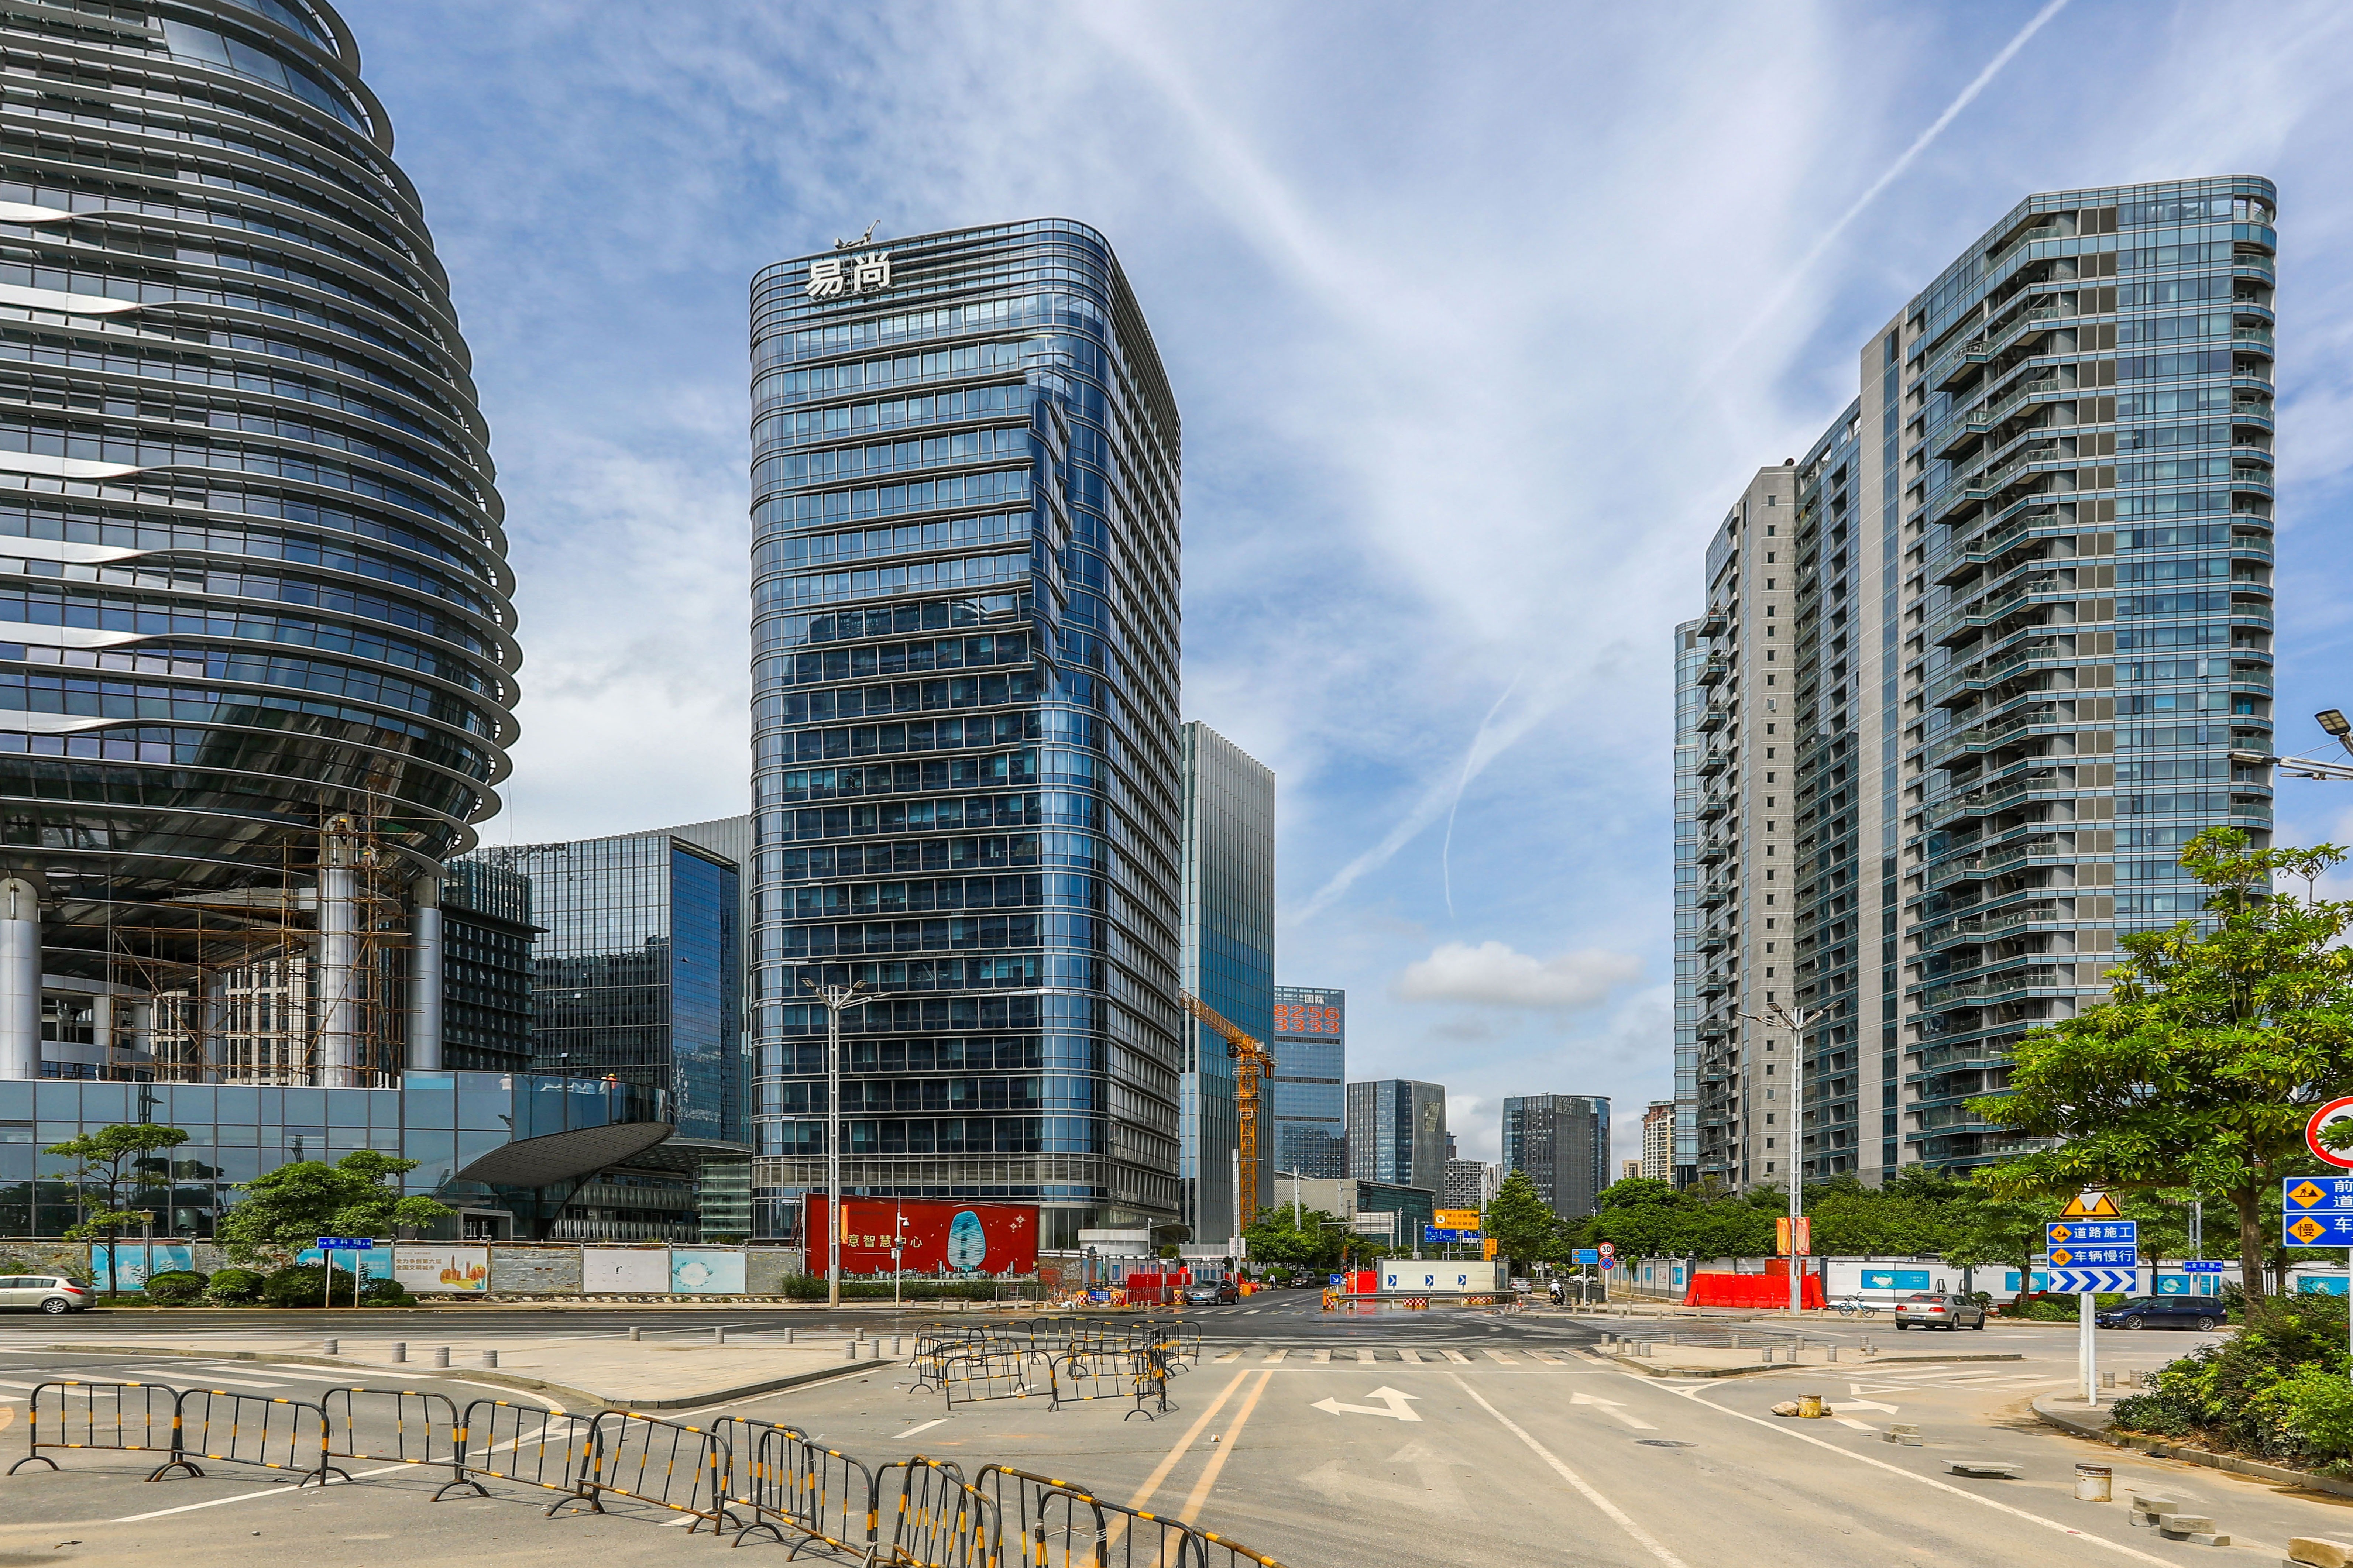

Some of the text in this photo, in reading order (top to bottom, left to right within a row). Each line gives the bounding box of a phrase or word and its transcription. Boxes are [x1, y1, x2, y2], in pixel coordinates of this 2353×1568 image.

[805, 251, 891, 296] 易尚
[1305, 994, 1325, 1004] 国际
[1274, 1004, 1340, 1020] 8256
[1274, 1018, 1340, 1034] 3333
[2333, 1180, 2353, 1192] 前
[2333, 1195, 2353, 1207] 道
[2298, 1224, 2314, 1237] 慢
[2334, 1217, 2353, 1233] 车
[2074, 1226, 2132, 1239] 道路施工
[838, 1234, 923, 1248] 意智慧中心
[2056, 1253, 2067, 1262] 慢
[2074, 1250, 2133, 1262] 车辆慢行
